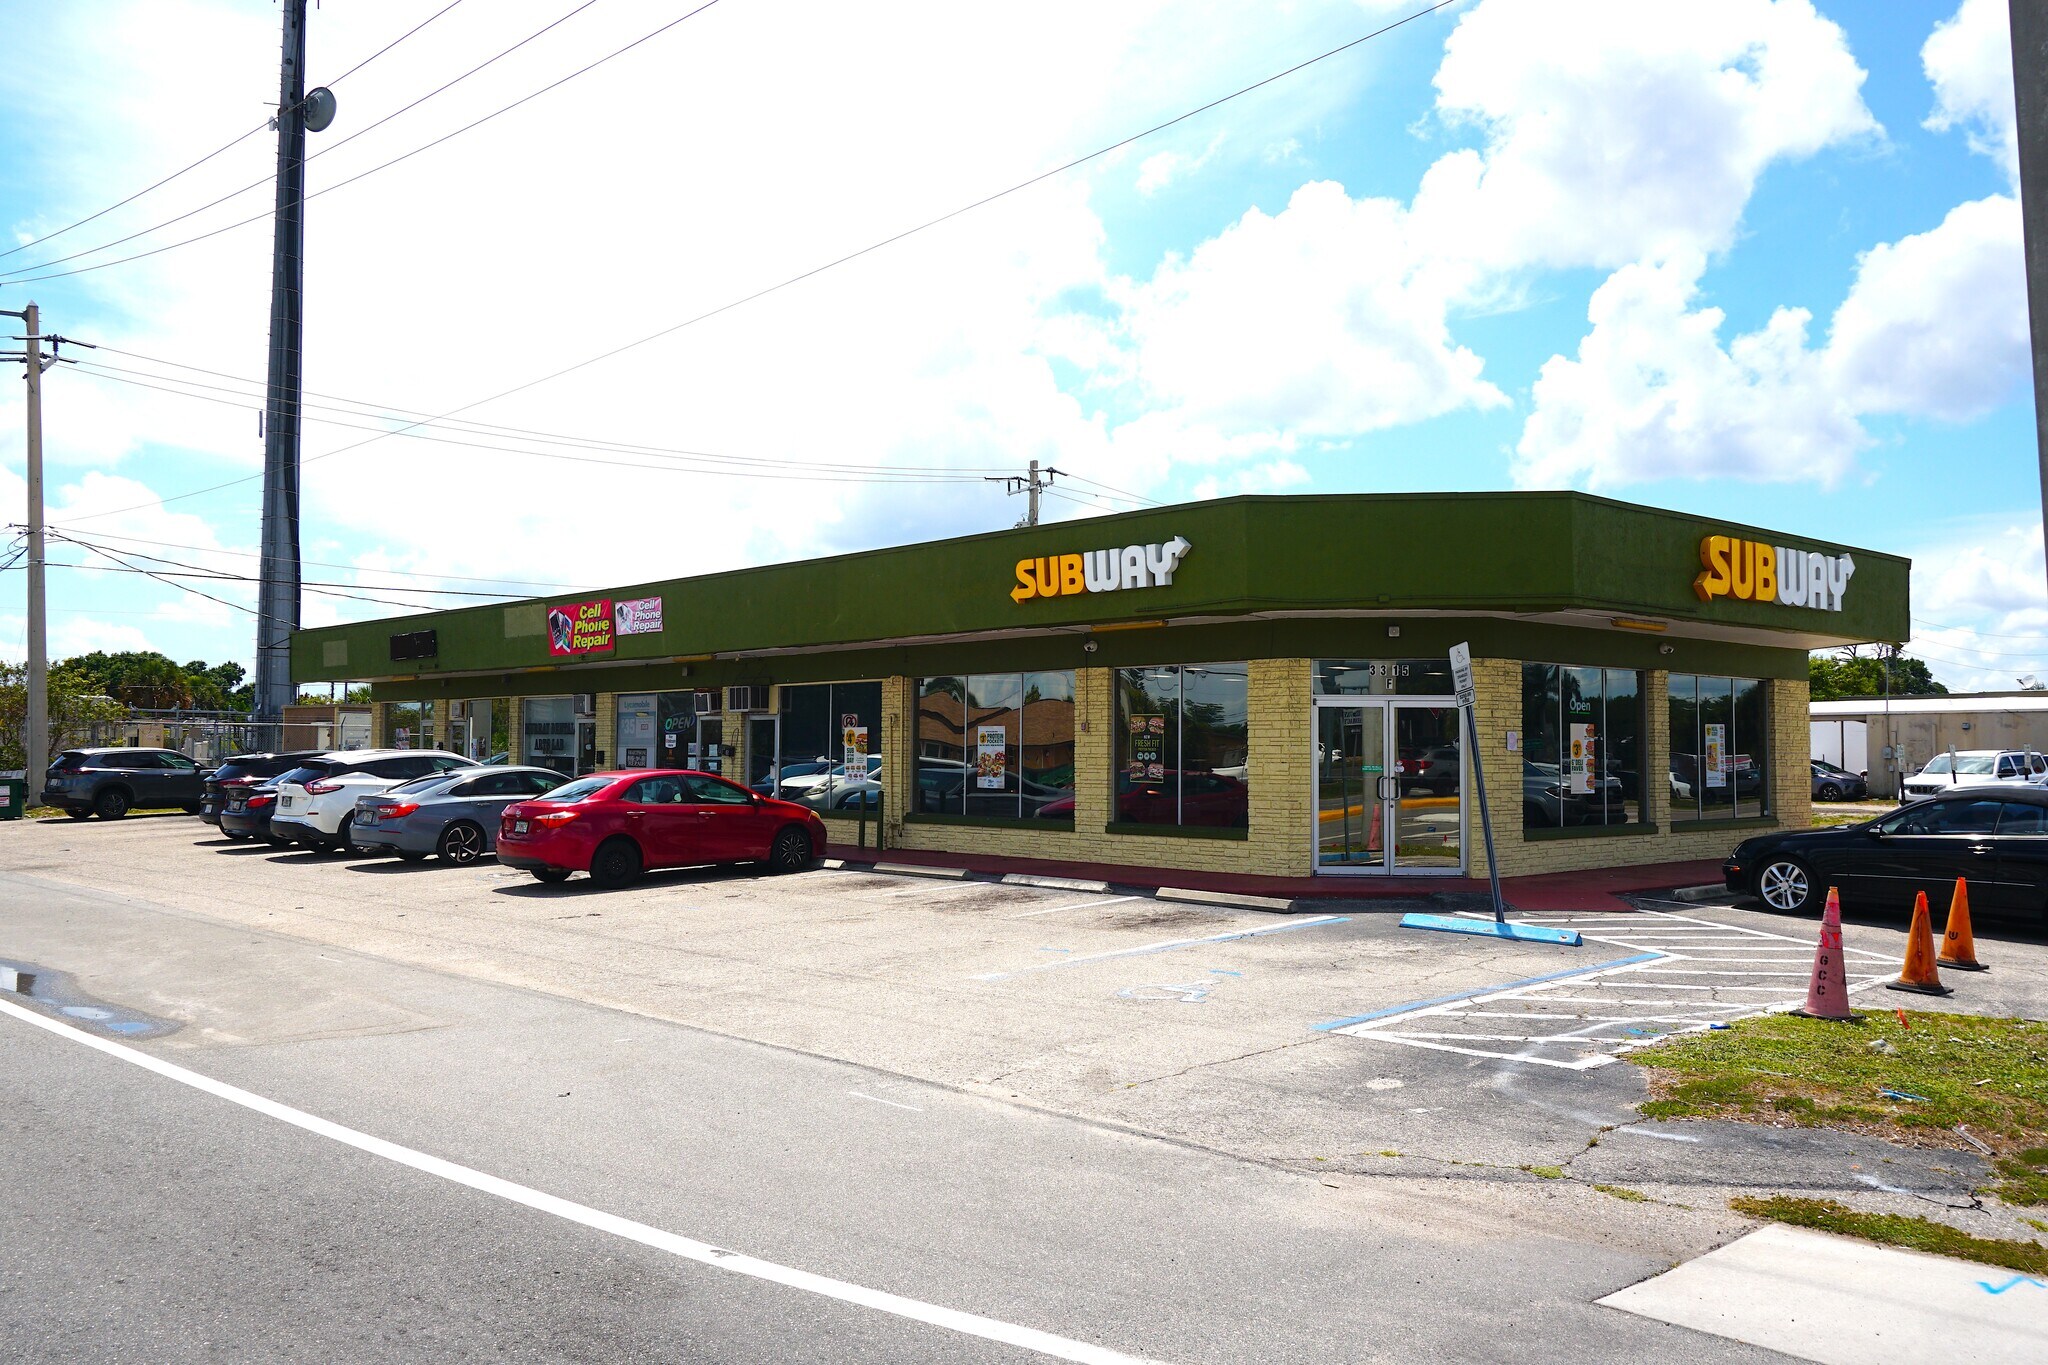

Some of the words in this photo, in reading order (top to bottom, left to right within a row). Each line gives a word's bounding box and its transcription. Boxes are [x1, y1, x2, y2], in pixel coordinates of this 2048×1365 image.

[1010, 536, 1192, 605] SUBWAY
[1693, 535, 1856, 612] SUBWAY
[579, 603, 602, 619] Cell
[639, 600, 655, 611] Cell
[634, 610, 661, 621] Phone
[574, 619, 610, 634] Phone
[633, 619, 662, 632] Repair
[573, 633, 611, 650] Repair
[1386, 678, 1392, 689] F
[1569, 699, 1591, 714] Open
[665, 717, 691, 731] OPEN
